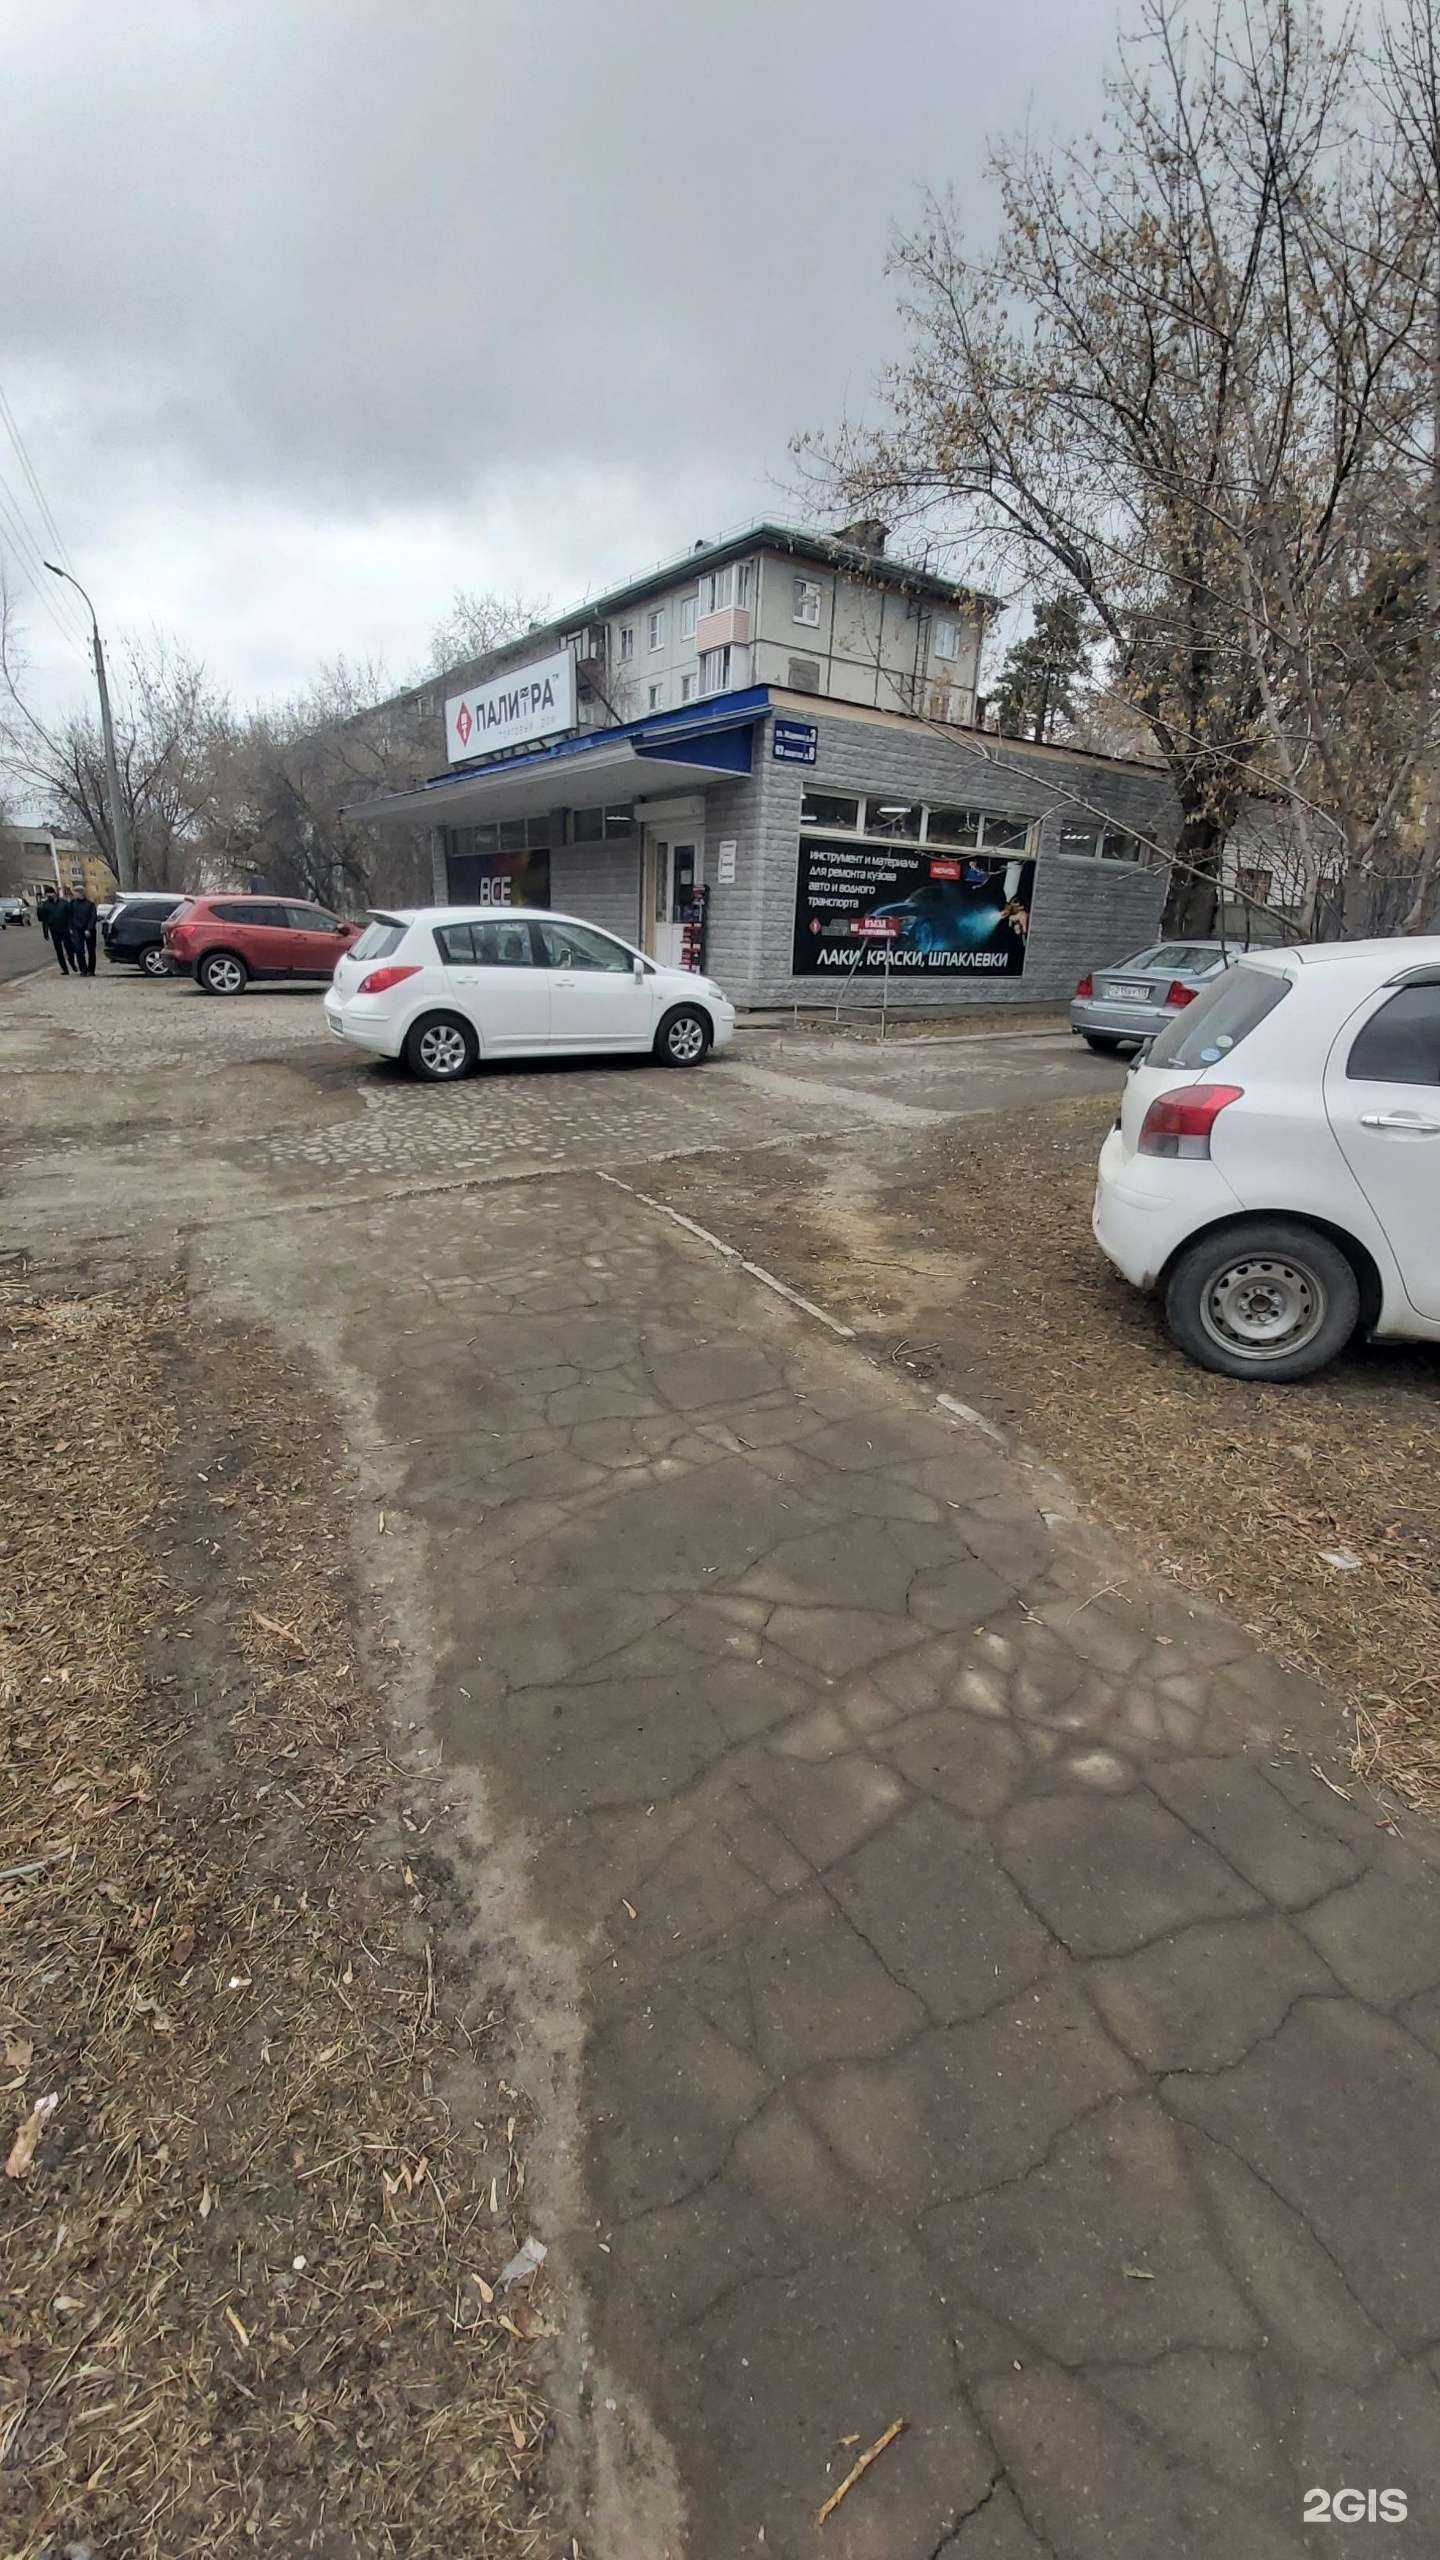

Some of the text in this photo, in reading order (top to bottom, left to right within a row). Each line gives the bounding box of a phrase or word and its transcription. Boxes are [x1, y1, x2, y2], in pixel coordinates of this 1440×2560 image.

[475, 678, 555, 733] ПАЛИТРА
[864, 856, 871, 865] и
[809, 866, 897, 882] для ремонта кузова
[480, 876, 512, 907] ВСЕ
[808, 881, 876, 895] авто и водного
[807, 896, 860, 910] транспорта
[816, 949, 1009, 968] ЛАКИ, КРАСКИ, ШПАКЛЕВКИ
